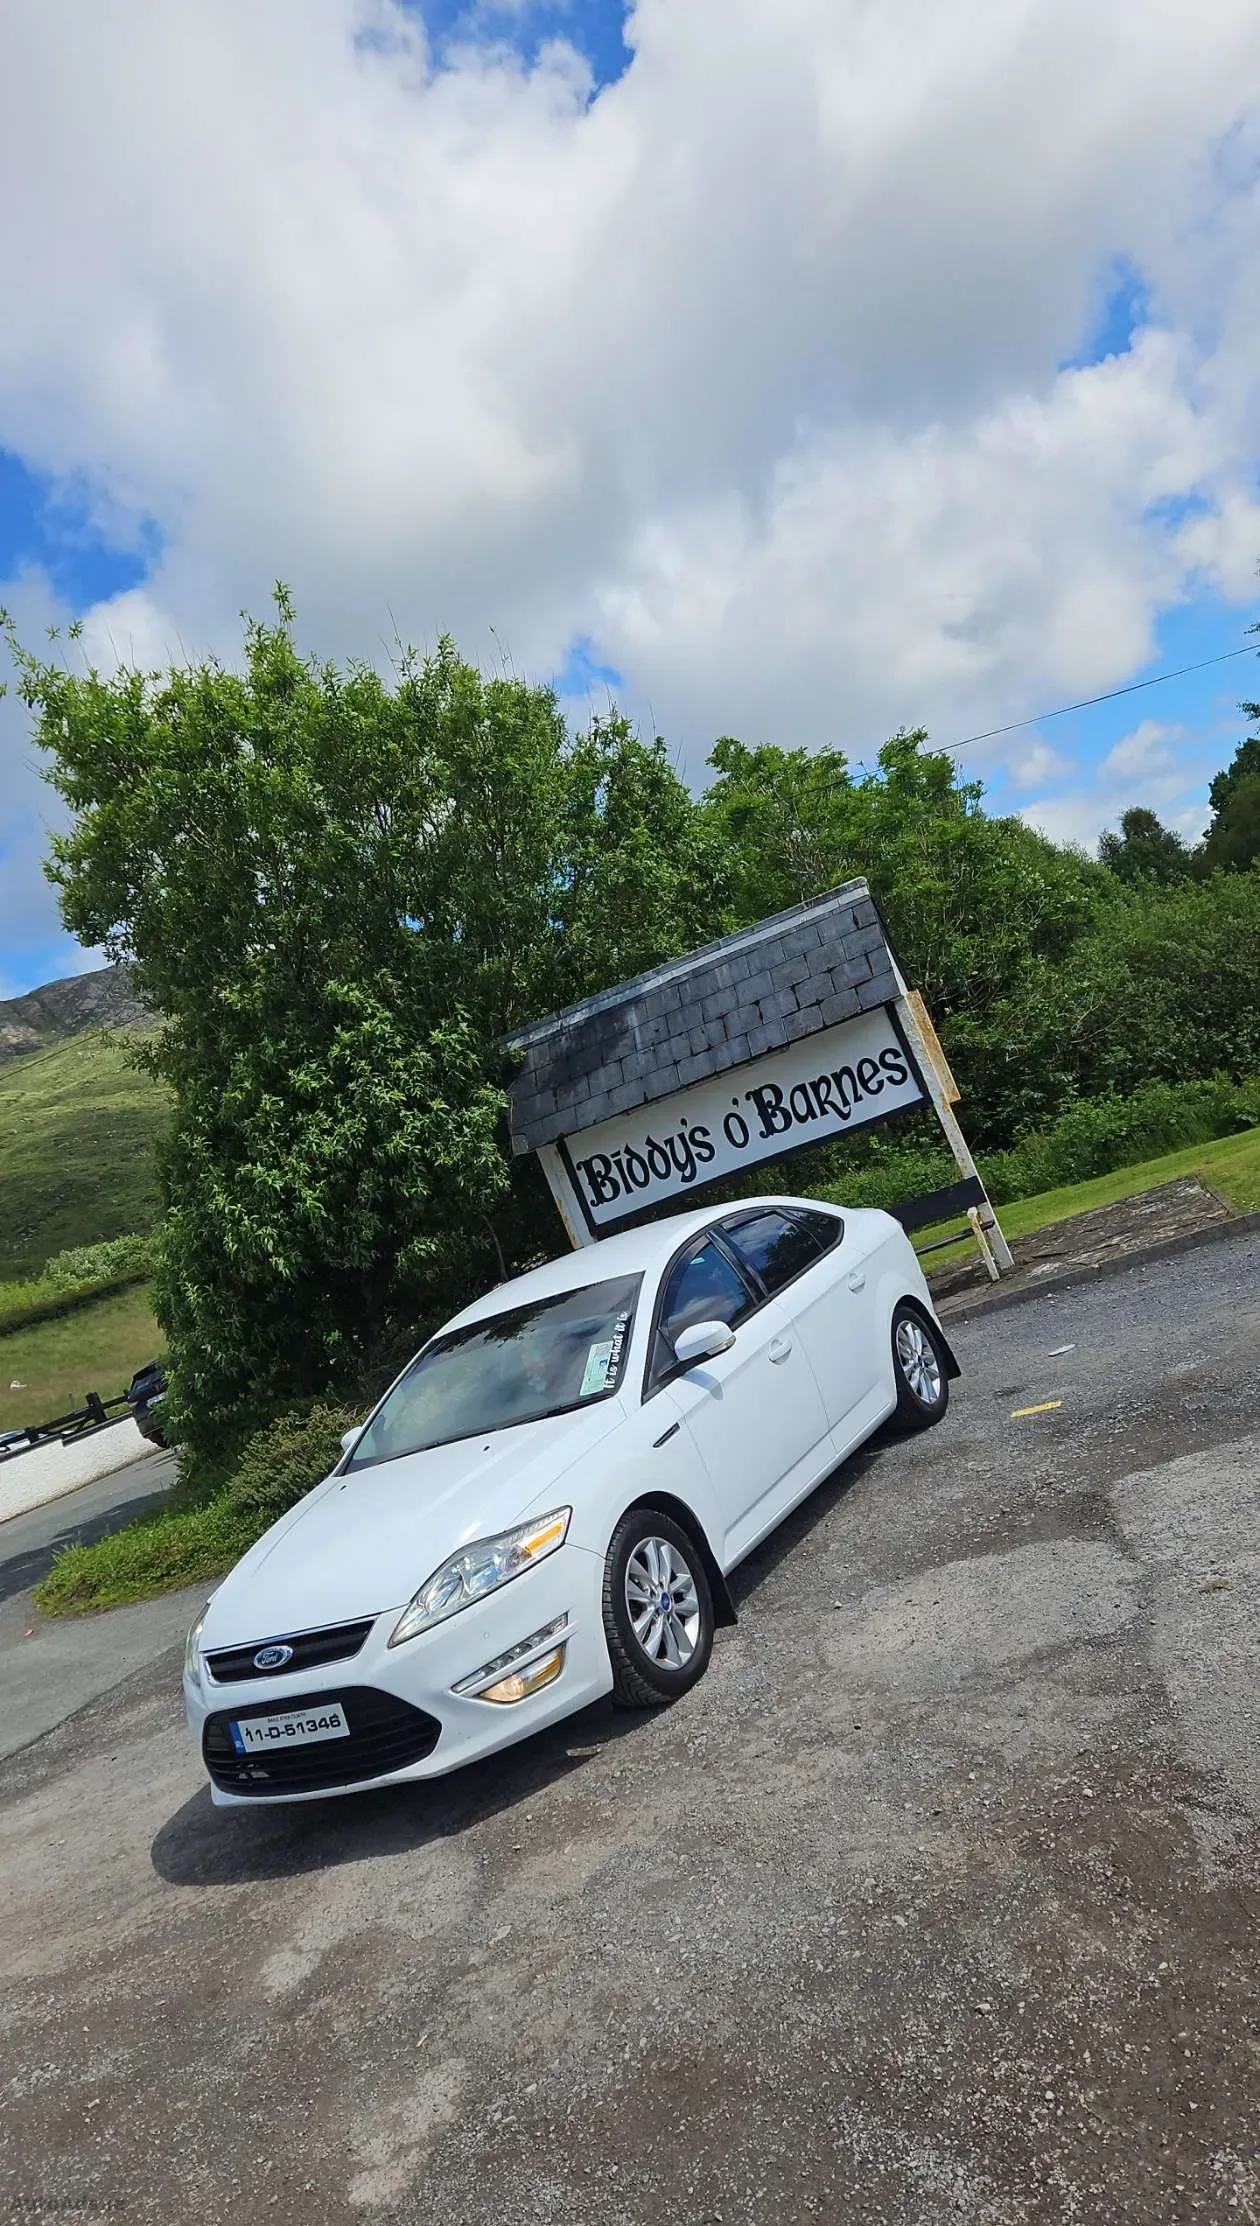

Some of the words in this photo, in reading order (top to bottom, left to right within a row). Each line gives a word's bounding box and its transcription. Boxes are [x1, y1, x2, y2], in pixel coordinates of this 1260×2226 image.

[577, 1118, 716, 1207] Biddy's
[611, 1333, 623, 1363] what
[608, 1364, 618, 1376] is
[604, 1377, 615, 1388] It
